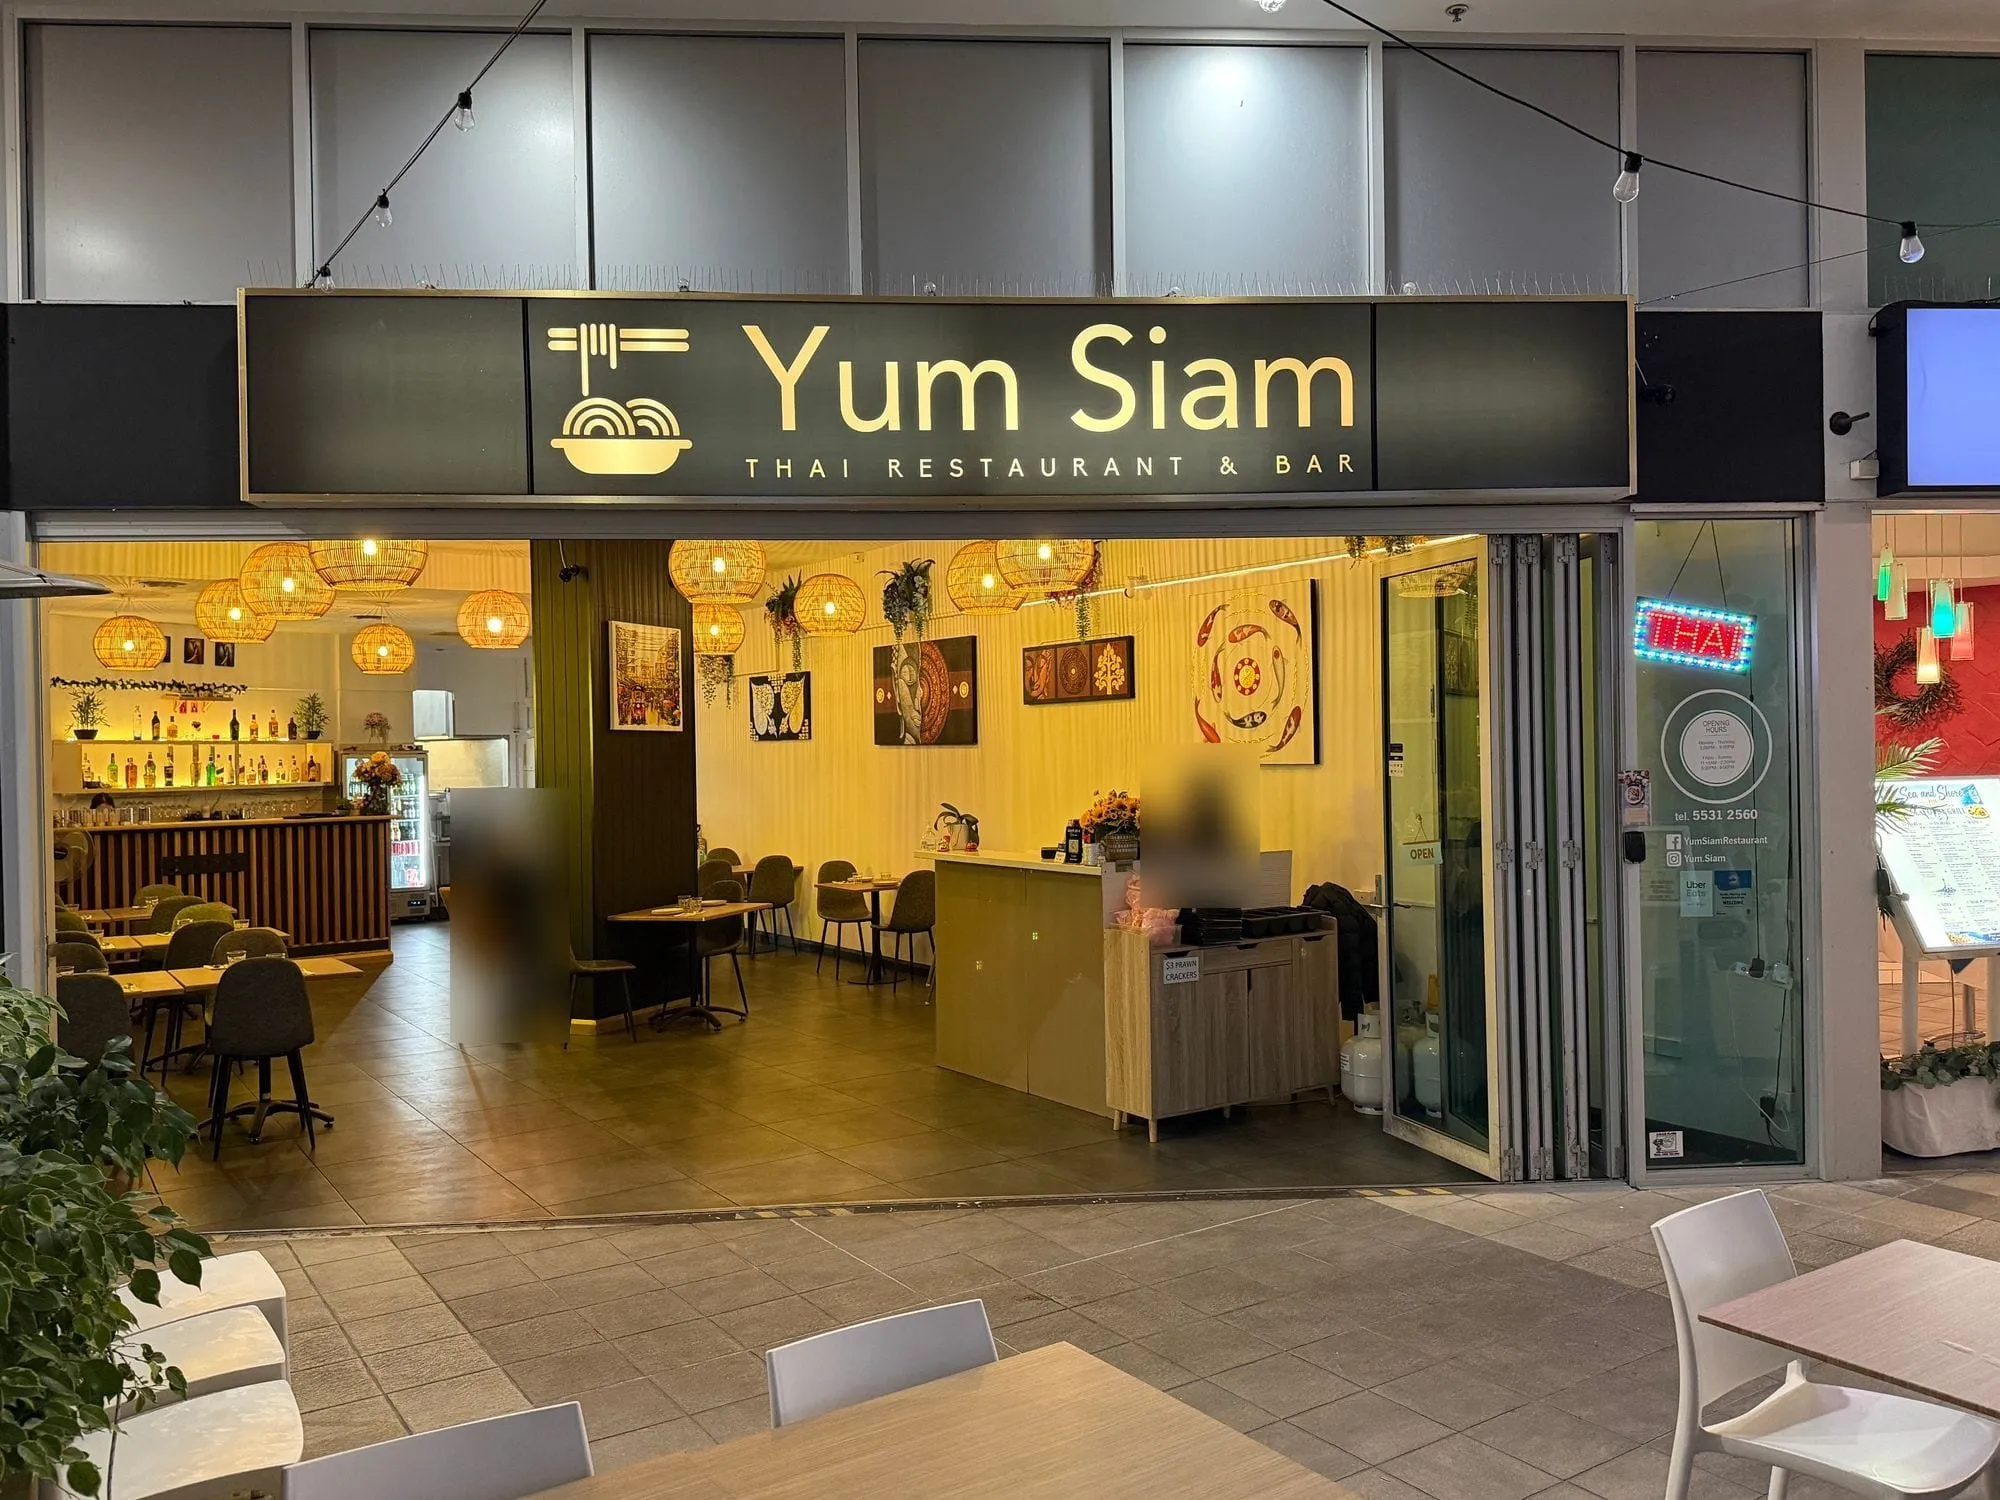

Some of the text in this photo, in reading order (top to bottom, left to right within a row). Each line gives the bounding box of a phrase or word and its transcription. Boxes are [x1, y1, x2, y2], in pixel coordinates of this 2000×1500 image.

[742, 323, 1354, 433] Yum Siam
[746, 454, 1354, 479] THAI RESTAURANT & BAR
[1645, 611, 1740, 659] THAI
[1703, 719, 1730, 728] OPENING
[1899, 784, 1963, 802] Sea and Shore
[1674, 809, 1758, 822] tel. 5531 2560
[1684, 836, 1768, 845] YumSiamRestaurant
[1409, 847, 1435, 861] OPEN
[1684, 854, 1726, 863] Yum.Siam
[1686, 881, 1706, 889] Uber
[1165, 960, 1197, 971] $3 PRAWN
[1165, 970, 1198, 981] CRACKERS
